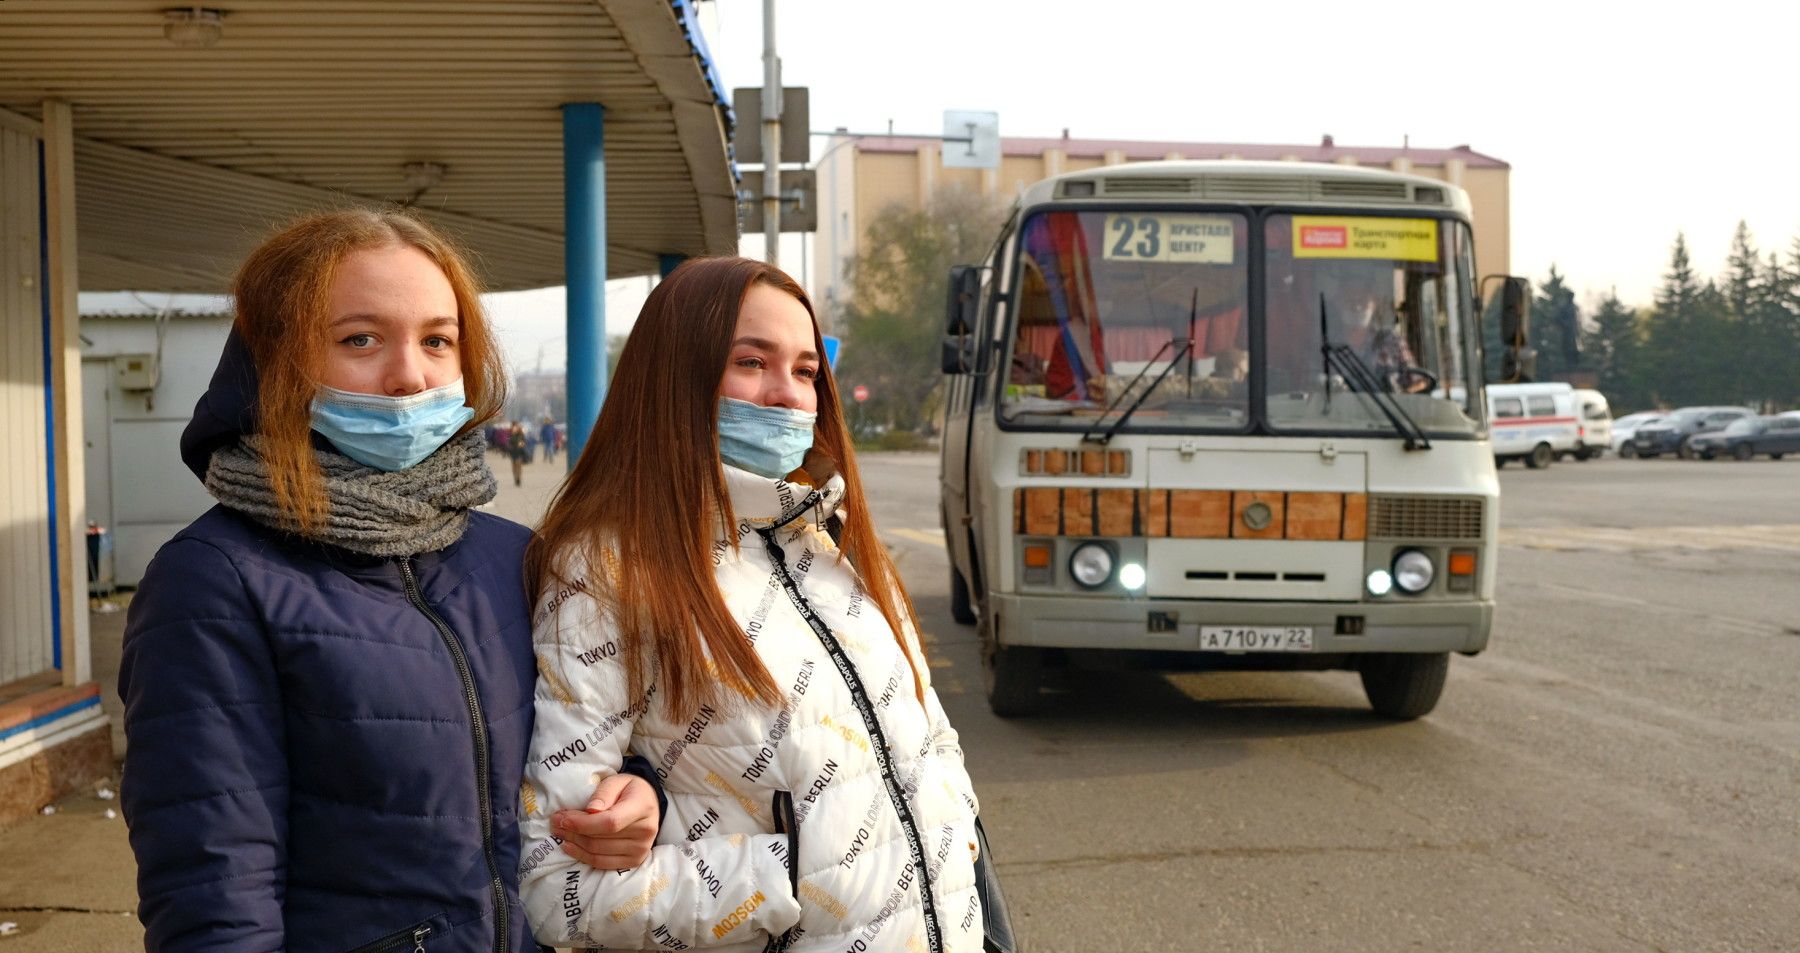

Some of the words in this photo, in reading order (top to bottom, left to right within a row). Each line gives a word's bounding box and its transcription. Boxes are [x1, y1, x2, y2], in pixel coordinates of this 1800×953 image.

[1111, 216, 1161, 259] 23
[1170, 240, 1206, 254] ЦЕНТР
[1352, 227, 1431, 240] Транспортная
[1353, 240, 1387, 249] карта
[547, 577, 588, 613] BERLIN
[785, 586, 812, 619] MEGAPOLIS
[577, 641, 617, 668] TOKYO
[1288, 630, 1307, 643] 22
[832, 652, 858, 690] MEGAPOLIS
[684, 703, 716, 744] BERLIN
[741, 747, 774, 783] TOKYO
[793, 659, 816, 696] BERLIN
[541, 738, 588, 772] TOKYO
[869, 733, 889, 776] MEGAPOLIS
[803, 758, 839, 804] BERLIN
[519, 839, 555, 880] NDON
[768, 840, 790, 870] RLIN
[839, 827, 870, 870] TOKYO
[900, 820, 922, 863] MEGAPOLIS
[563, 870, 582, 918] BERLIN
[696, 859, 723, 899] TOKYO
[712, 890, 766, 940] MOSCOW
[961, 895, 979, 934] TOKYO
